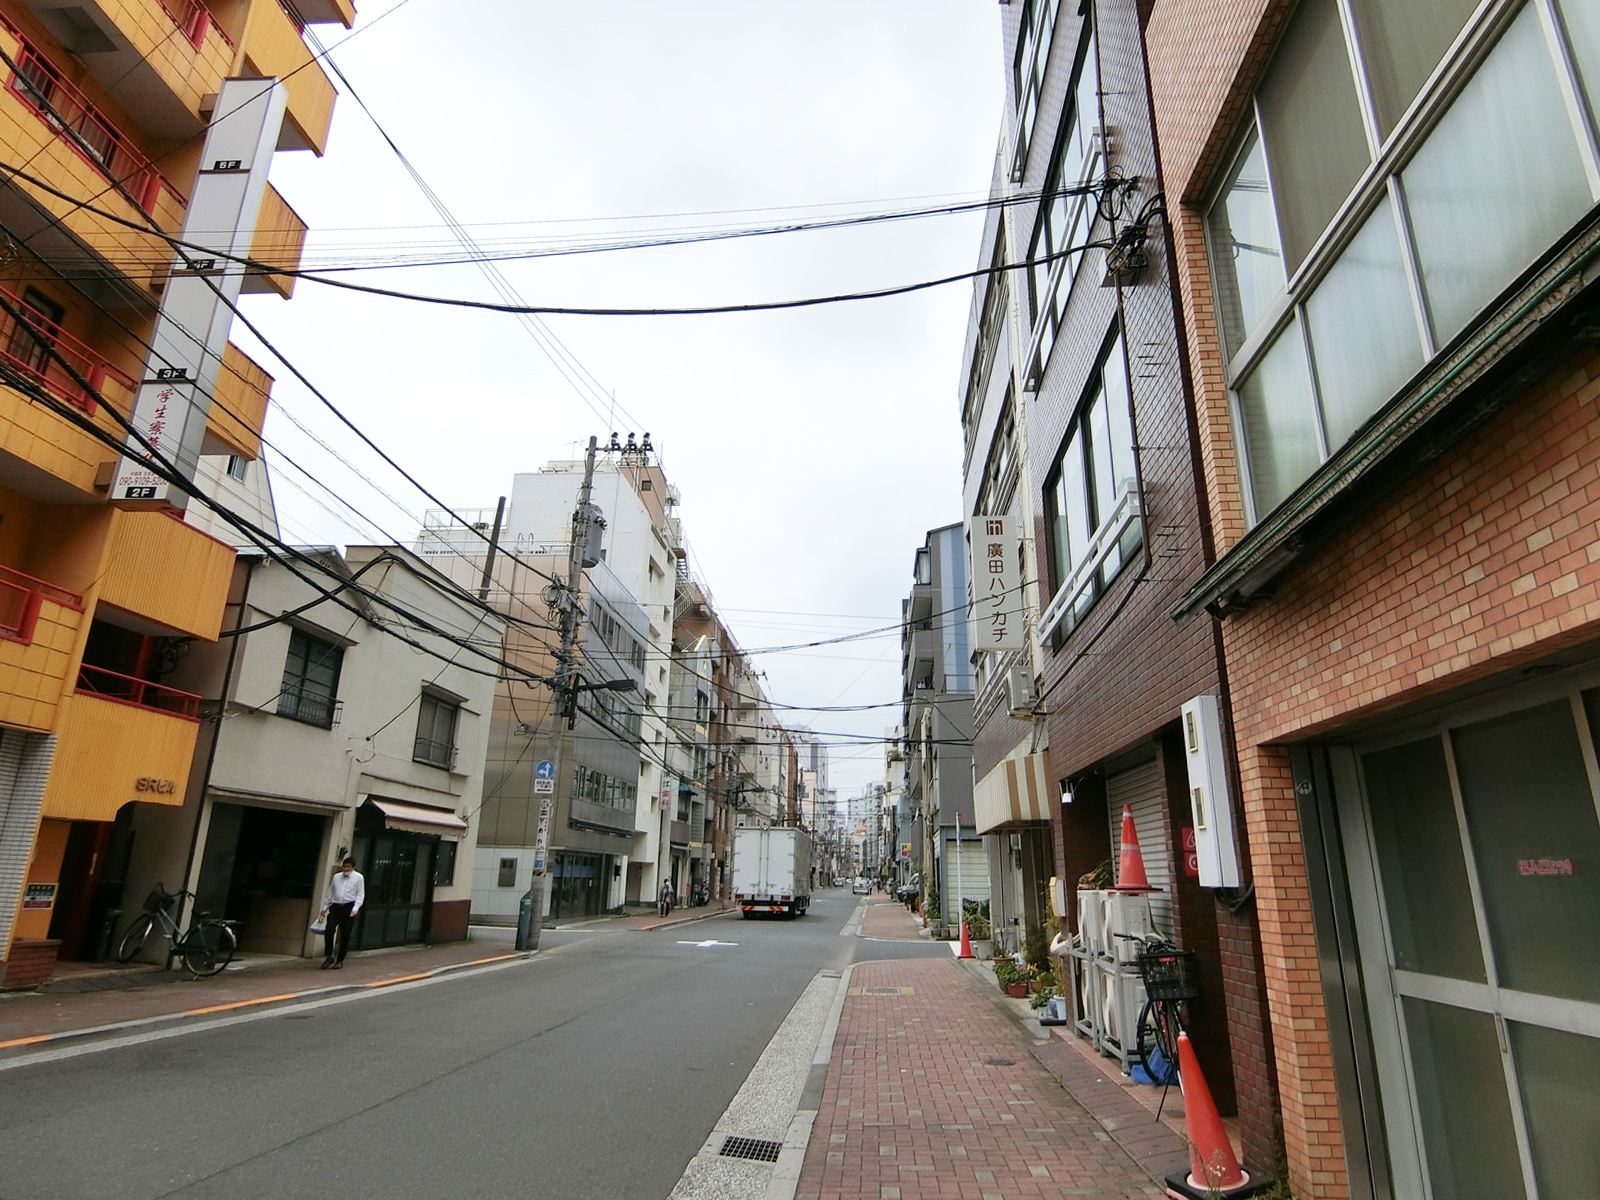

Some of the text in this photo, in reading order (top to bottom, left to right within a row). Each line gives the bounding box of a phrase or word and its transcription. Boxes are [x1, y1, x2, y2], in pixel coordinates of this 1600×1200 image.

[162, 369, 182, 378] 3F
[130, 487, 152, 498] 2F
[987, 542, 1008, 643] 廣田ハンカチ
[135, 776, 175, 795] SRビル
